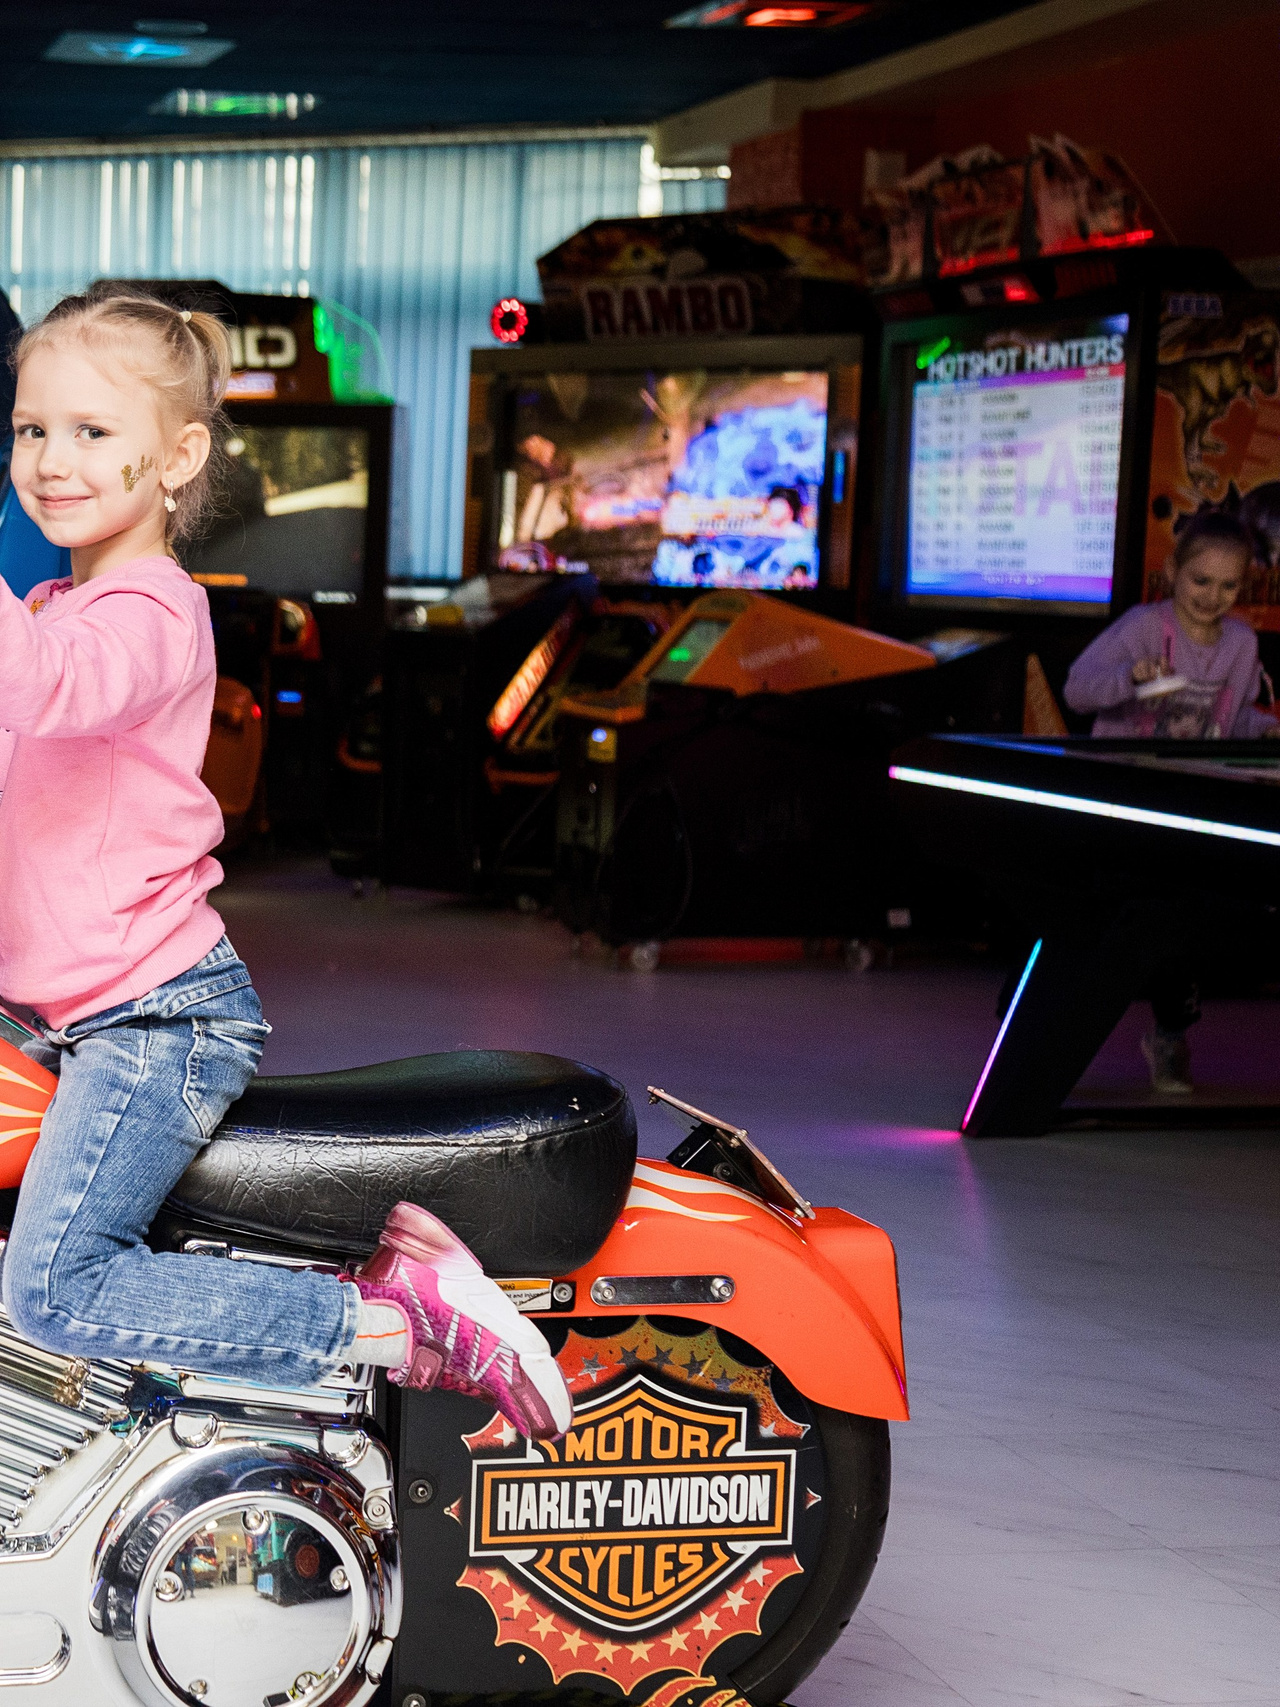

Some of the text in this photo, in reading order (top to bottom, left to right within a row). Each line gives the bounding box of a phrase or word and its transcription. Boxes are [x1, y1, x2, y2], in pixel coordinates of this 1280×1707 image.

[584, 277, 750, 340] RAMBO
[927, 333, 1124, 384] HOTSHOT HUNTERS
[565, 1405, 710, 1462] MOTOR
[497, 1474, 771, 1531] HARLEY-DAVIDSON
[559, 1542, 703, 1607] CYCLES
